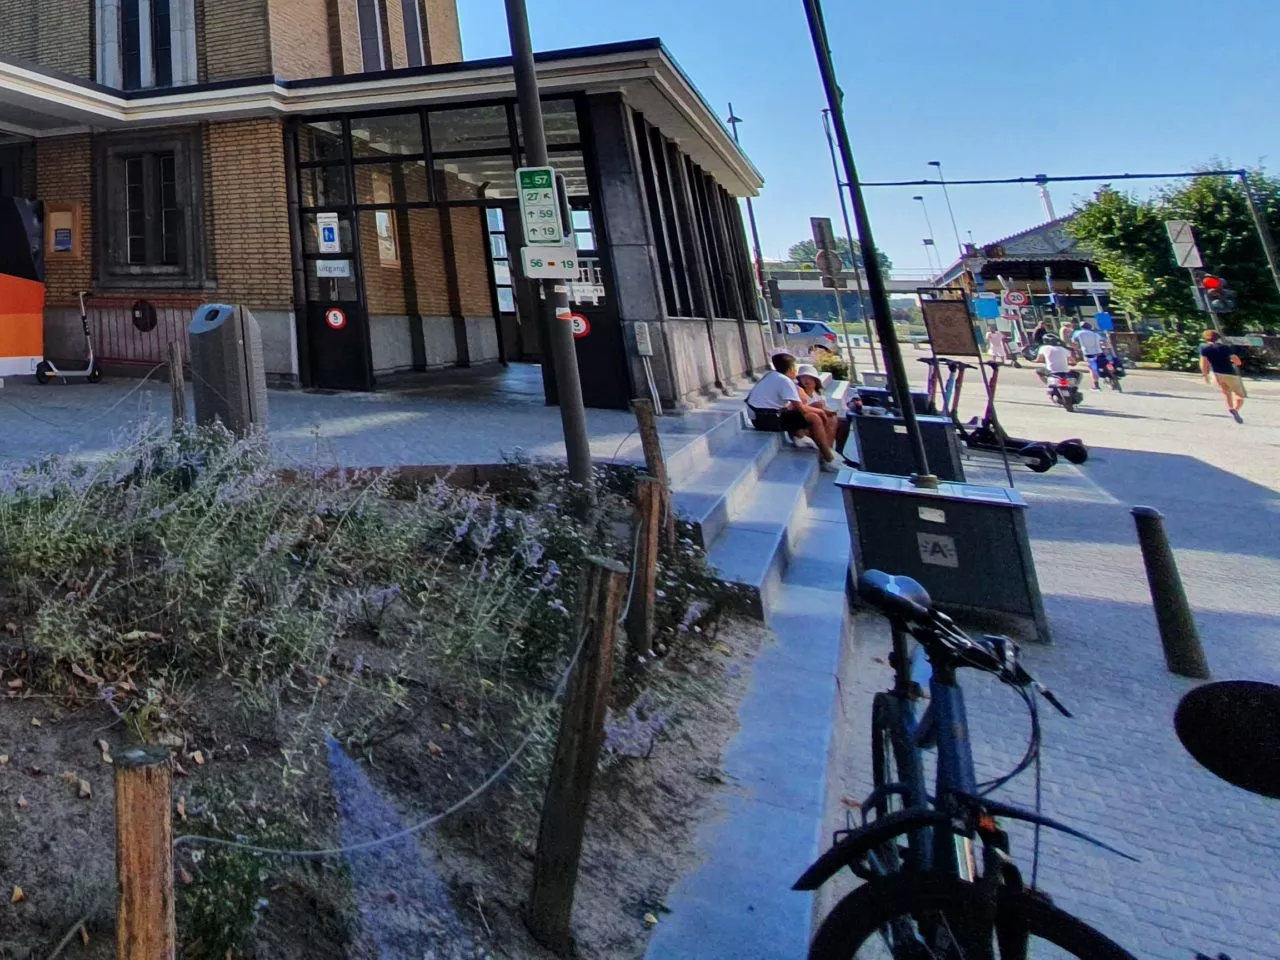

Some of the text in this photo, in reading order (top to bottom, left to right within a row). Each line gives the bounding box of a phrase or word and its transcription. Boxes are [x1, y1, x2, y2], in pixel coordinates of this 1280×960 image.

[534, 175, 548, 186] 57
[526, 192, 539, 201] 27
[539, 209, 553, 218] 59
[542, 226, 555, 236] 19
[319, 263, 346, 274] uitgang
[530, 258, 574, 269] 56 19
[332, 313, 339, 321] 5
[573, 319, 580, 328] 5
[929, 541, 948, 559] A
